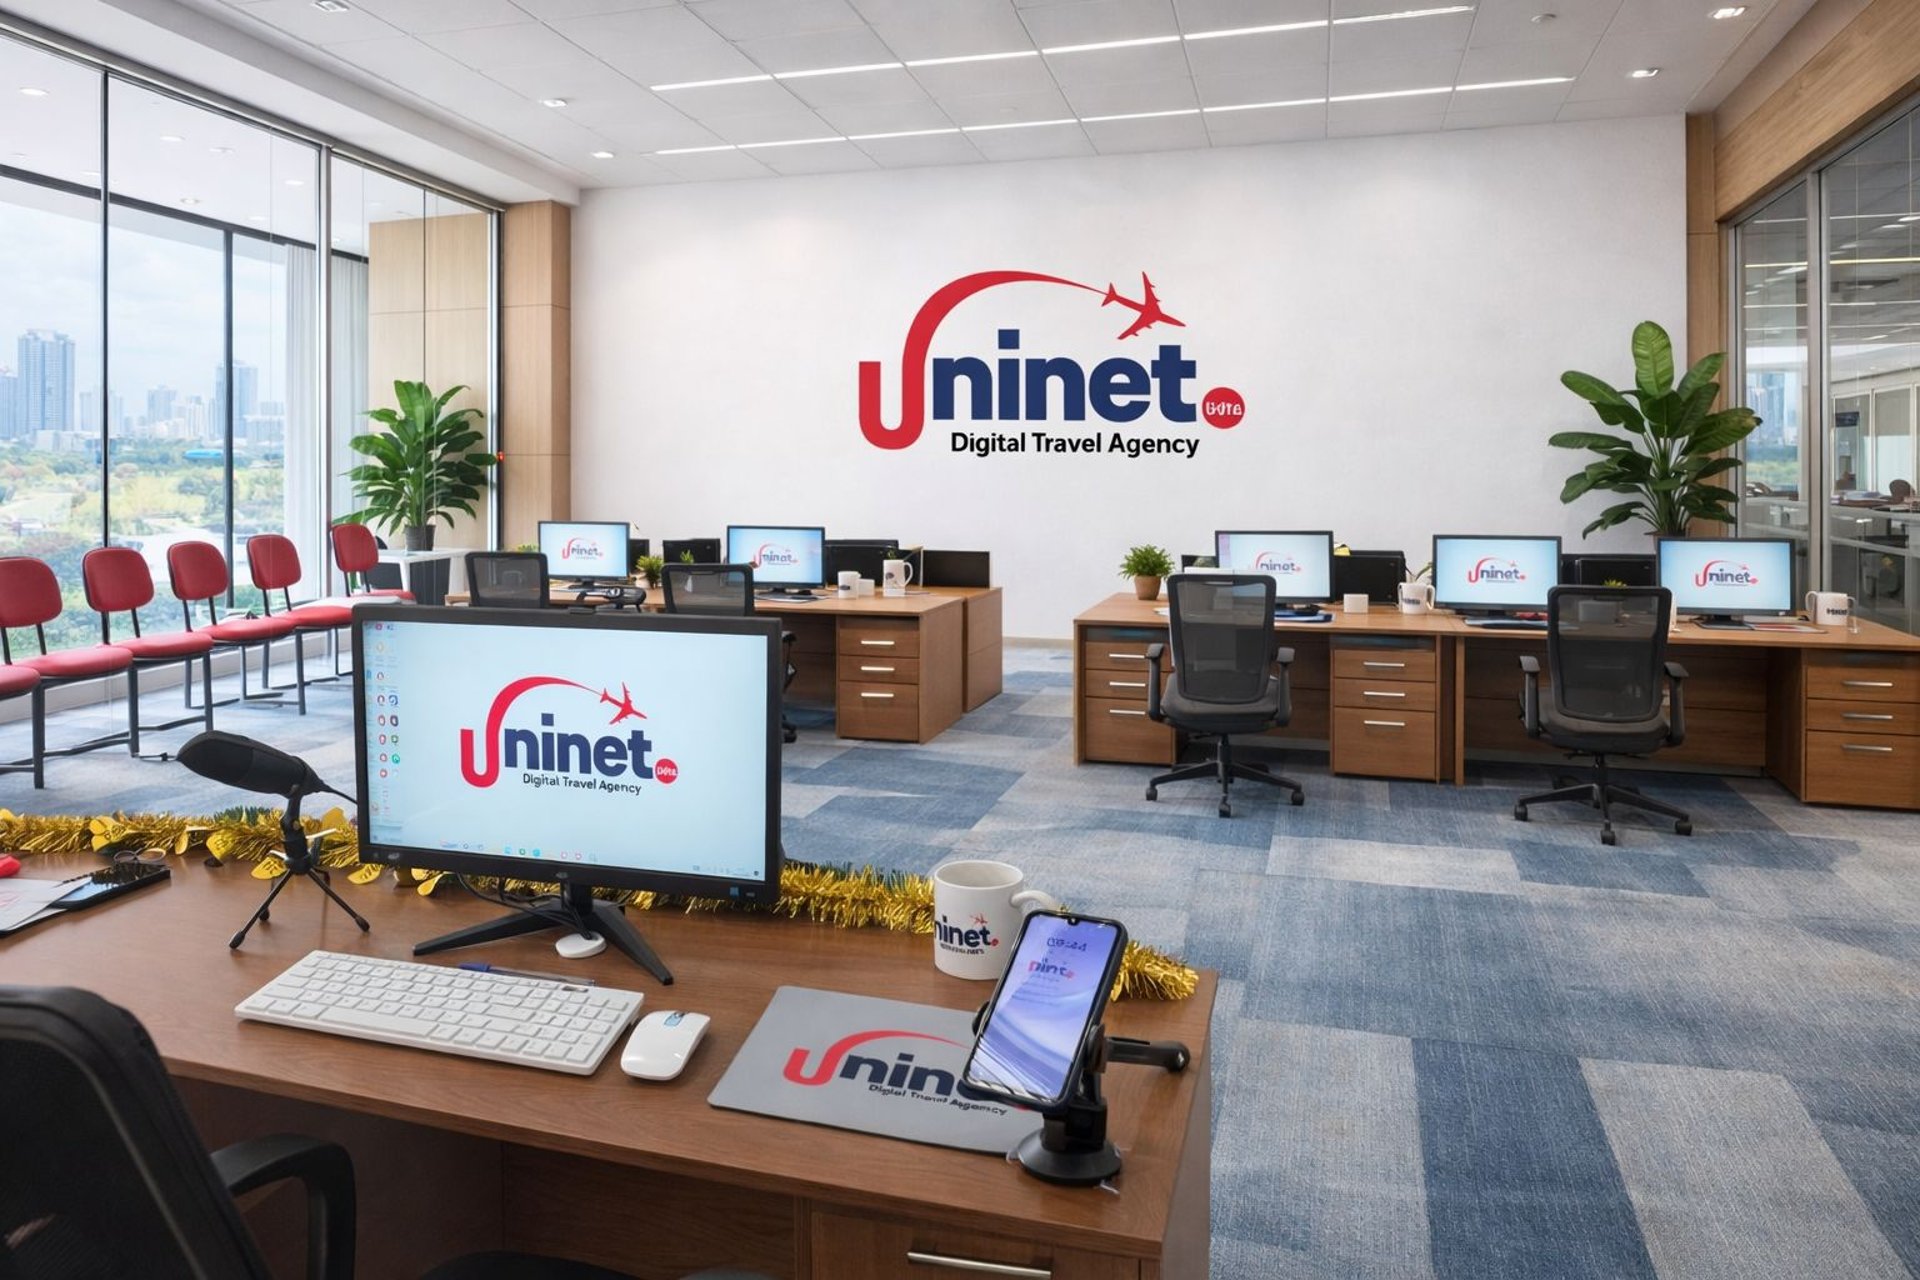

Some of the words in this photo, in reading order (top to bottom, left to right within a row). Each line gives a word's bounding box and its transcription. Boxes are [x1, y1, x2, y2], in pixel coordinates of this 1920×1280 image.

[859, 271, 1197, 449] Uninet
[951, 432, 1026, 457] Digital
[1032, 432, 1101, 453] Travel
[1108, 433, 1200, 458] Agency
[460, 676, 654, 788] Uninet
[523, 773, 559, 788] Digital
[562, 775, 597, 790] Travel
[599, 780, 642, 796] Agency
